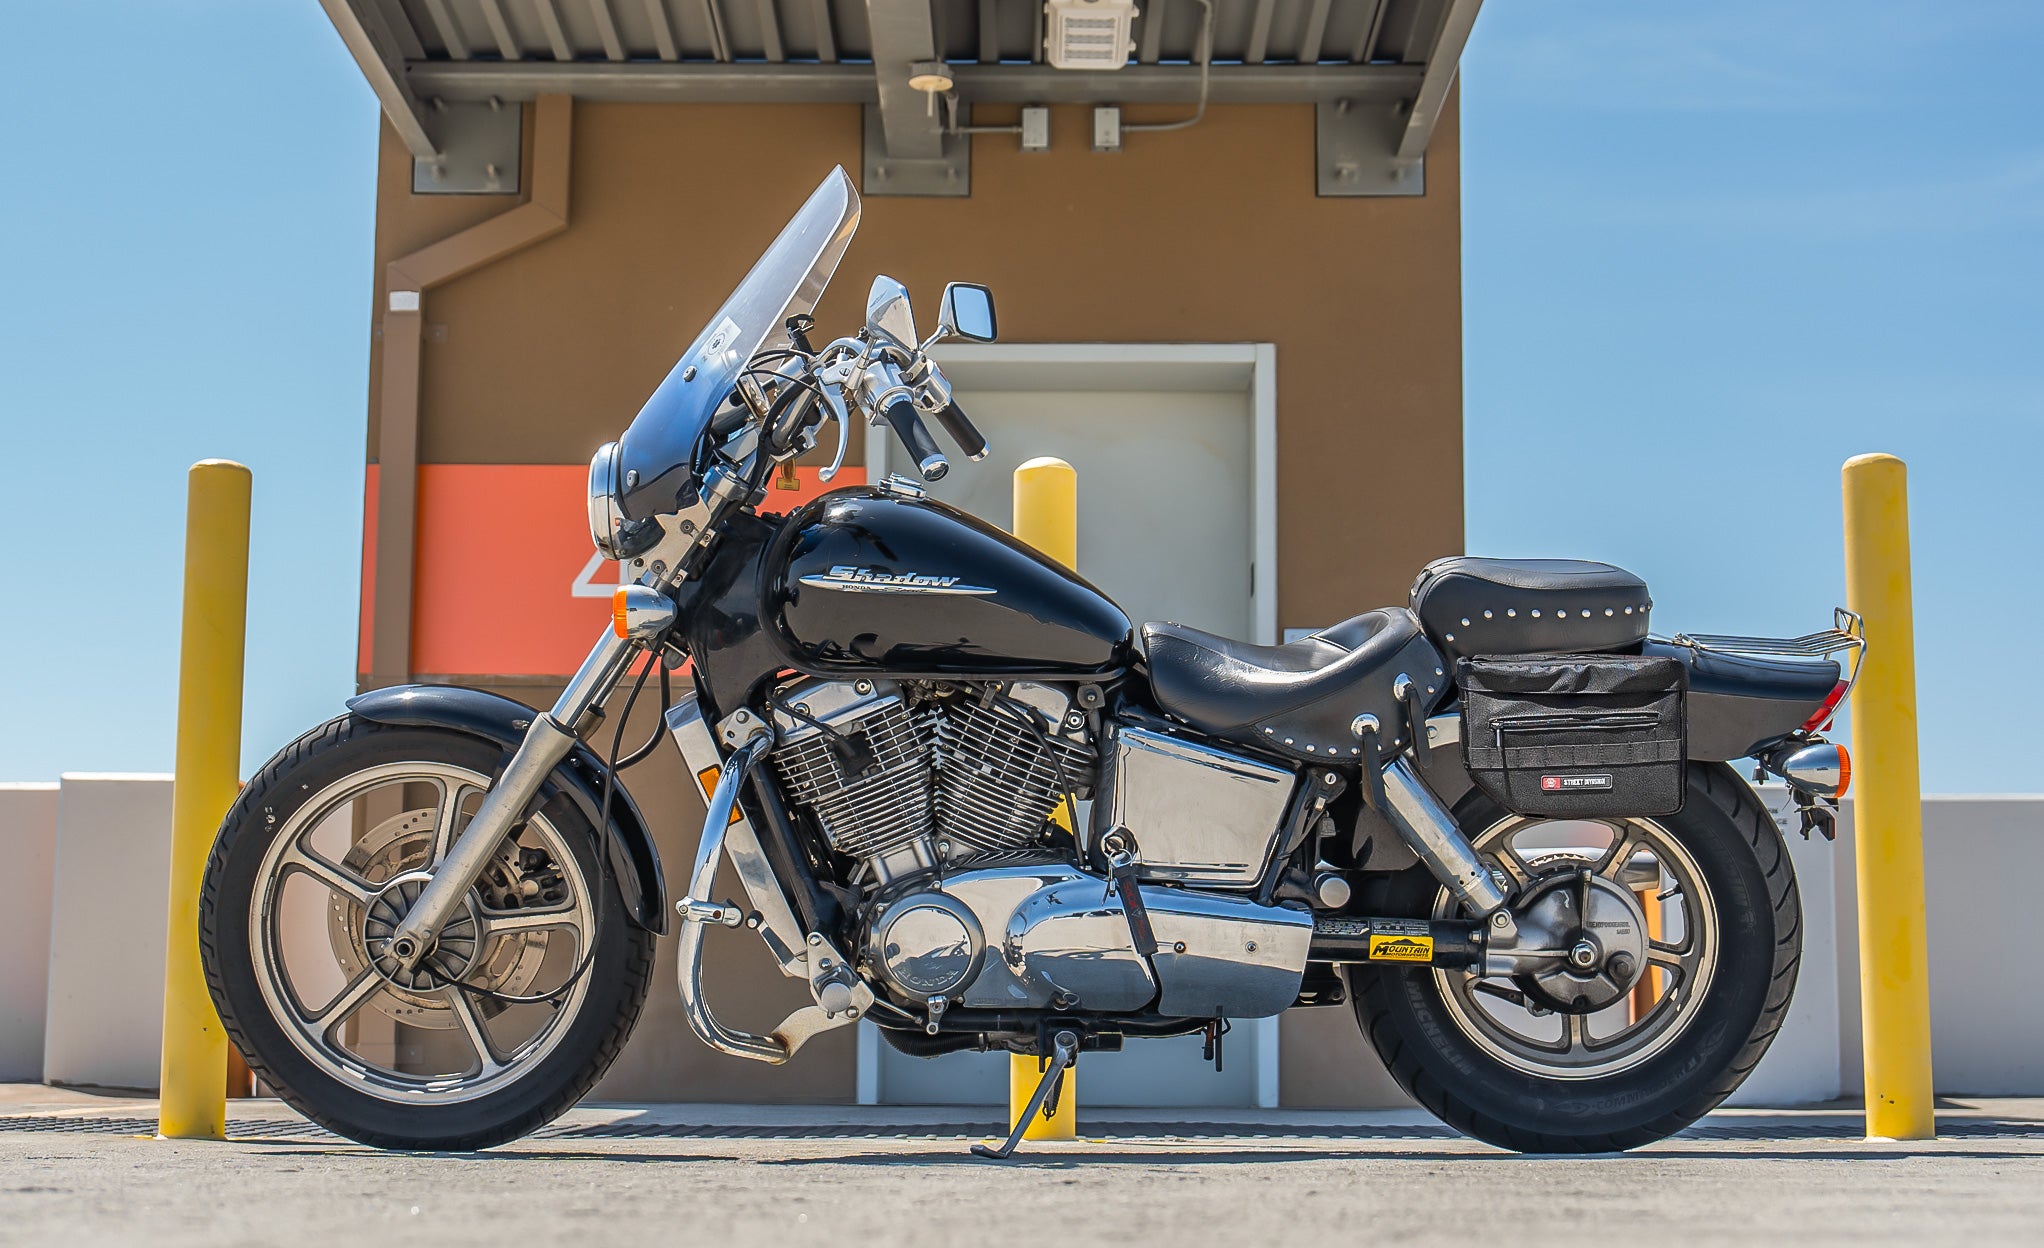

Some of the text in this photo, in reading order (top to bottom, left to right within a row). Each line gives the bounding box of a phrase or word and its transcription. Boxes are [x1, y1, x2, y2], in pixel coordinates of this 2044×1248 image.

[823, 565, 960, 587] Shadow
[1563, 778, 1583, 786] STREET
[1372, 945, 1430, 955] MOUNTAIN
[896, 967, 960, 987] HONDA
[1406, 981, 1476, 1075] MICHELIN
